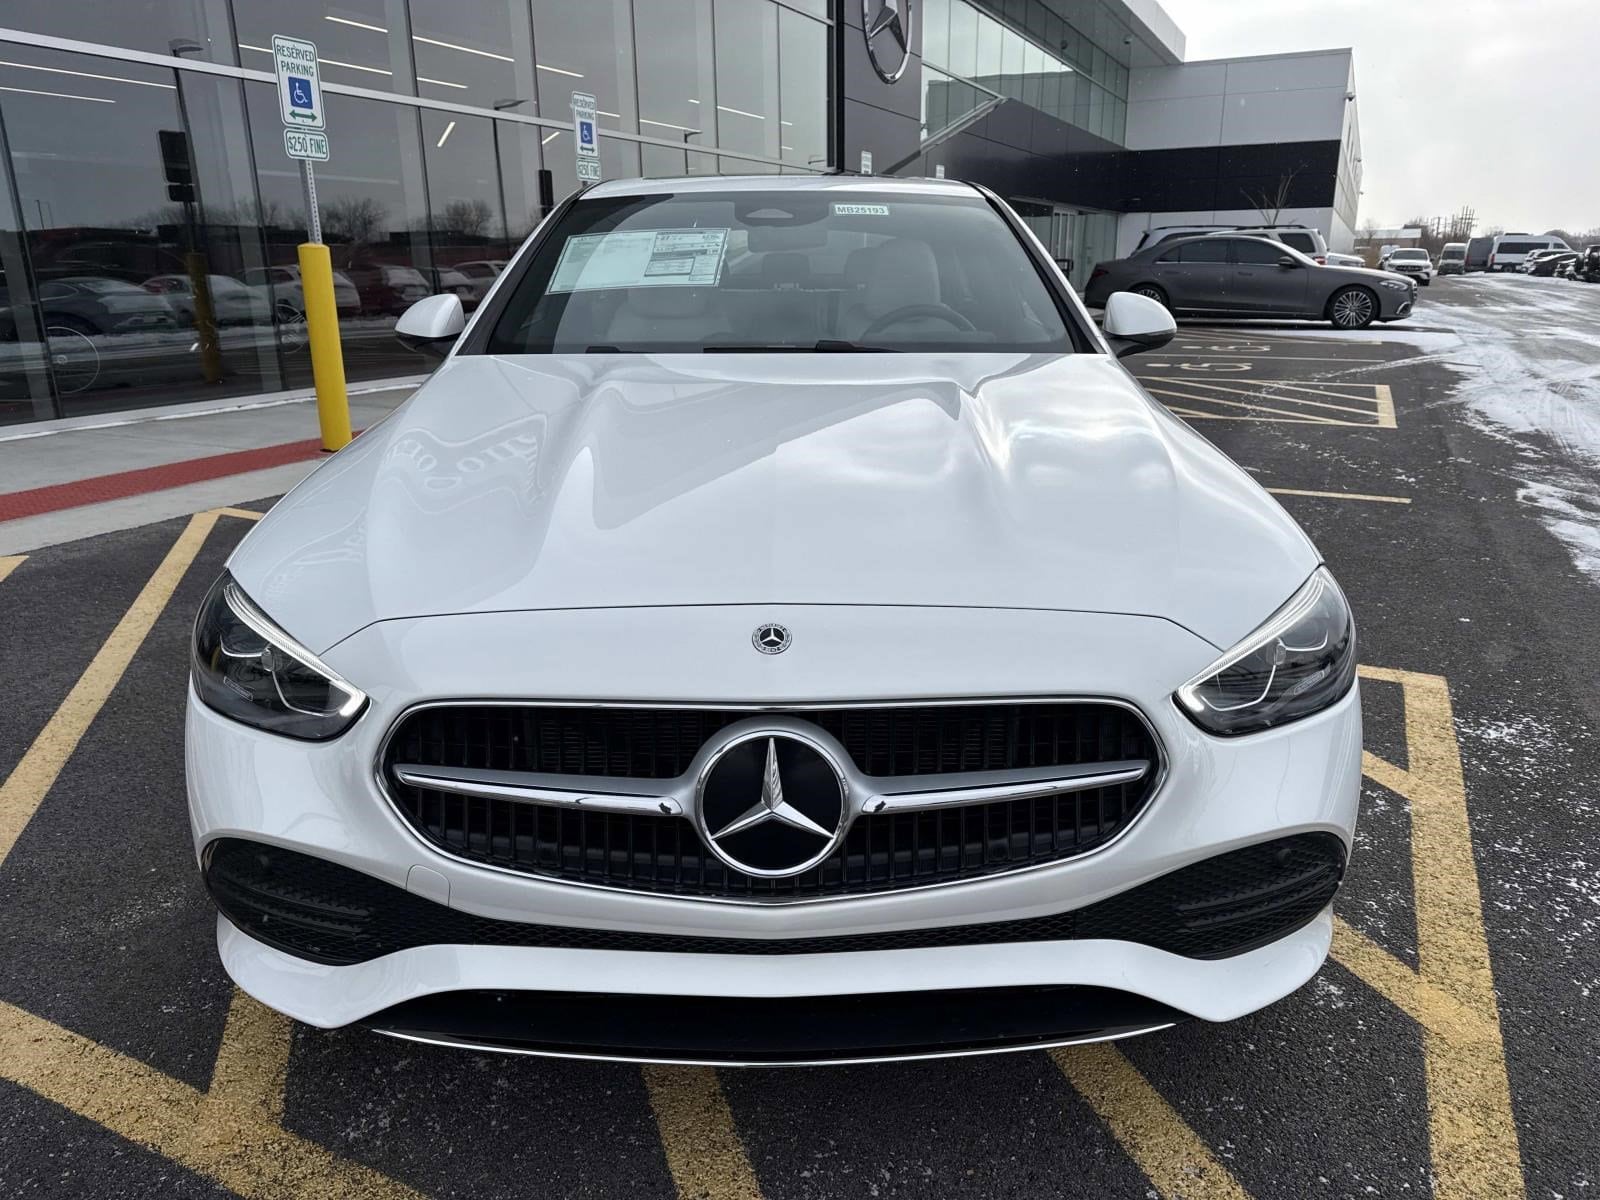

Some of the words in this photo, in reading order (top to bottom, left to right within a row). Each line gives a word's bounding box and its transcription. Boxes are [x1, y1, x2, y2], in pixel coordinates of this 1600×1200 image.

[276, 44, 314, 62] RESERVED
[281, 60, 314, 77] PARKING
[288, 136, 307, 152] $250
[310, 138, 327, 154] FINE
